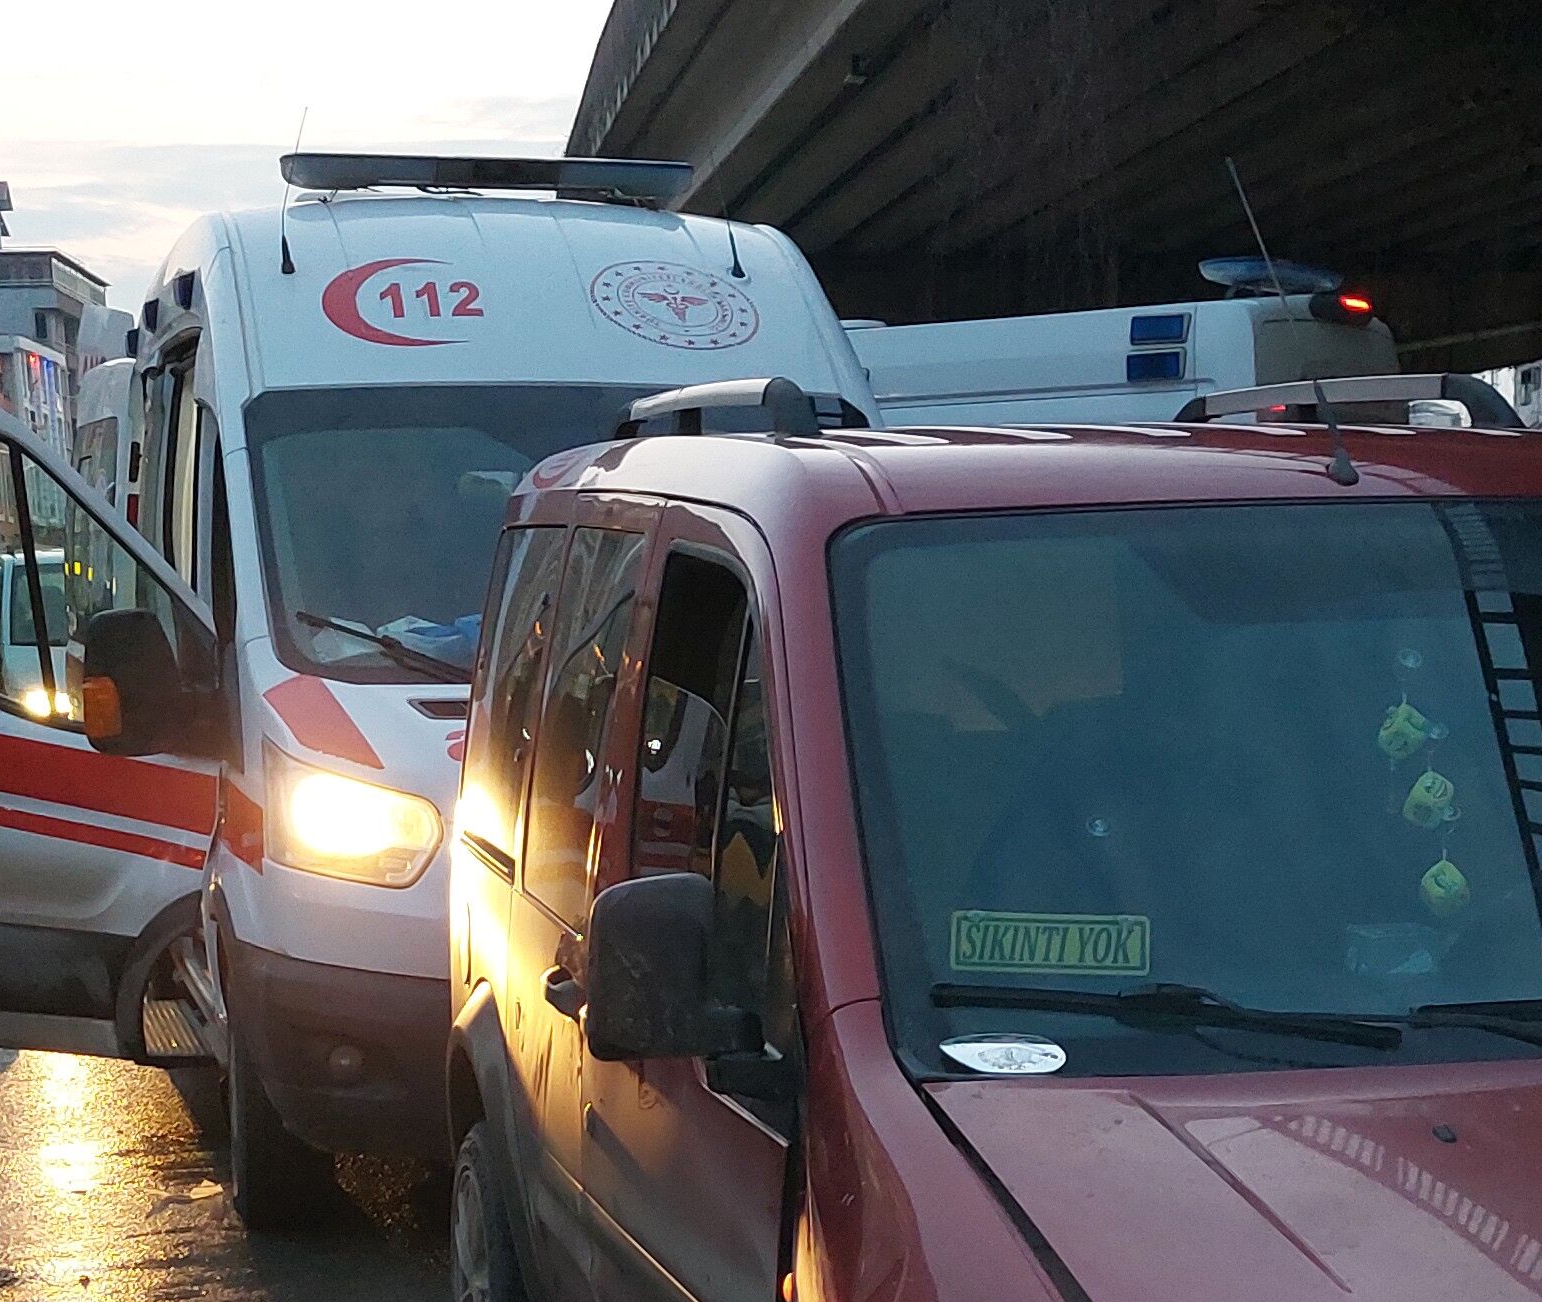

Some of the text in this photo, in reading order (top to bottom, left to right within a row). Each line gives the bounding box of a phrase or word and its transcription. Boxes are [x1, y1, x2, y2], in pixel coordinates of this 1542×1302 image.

[379, 281, 484, 318] 112
[963, 924, 1135, 964] SIKINTI YOK
